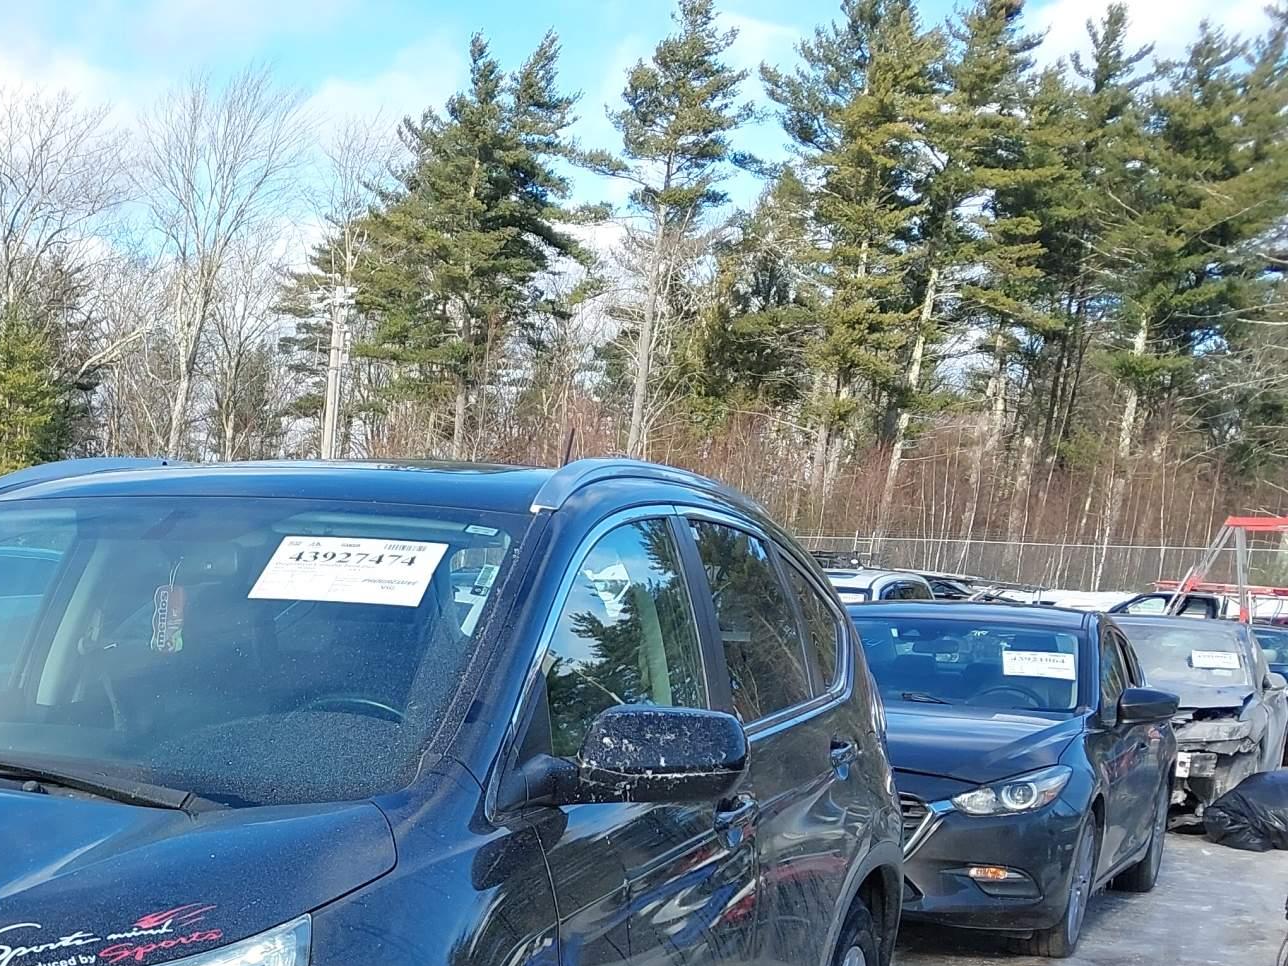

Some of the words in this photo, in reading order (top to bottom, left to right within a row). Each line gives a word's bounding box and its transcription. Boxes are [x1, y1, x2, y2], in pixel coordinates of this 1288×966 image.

[288, 550, 417, 567] 43927474
[78, 953, 97, 966] by
[99, 928, 224, 964] Sports
